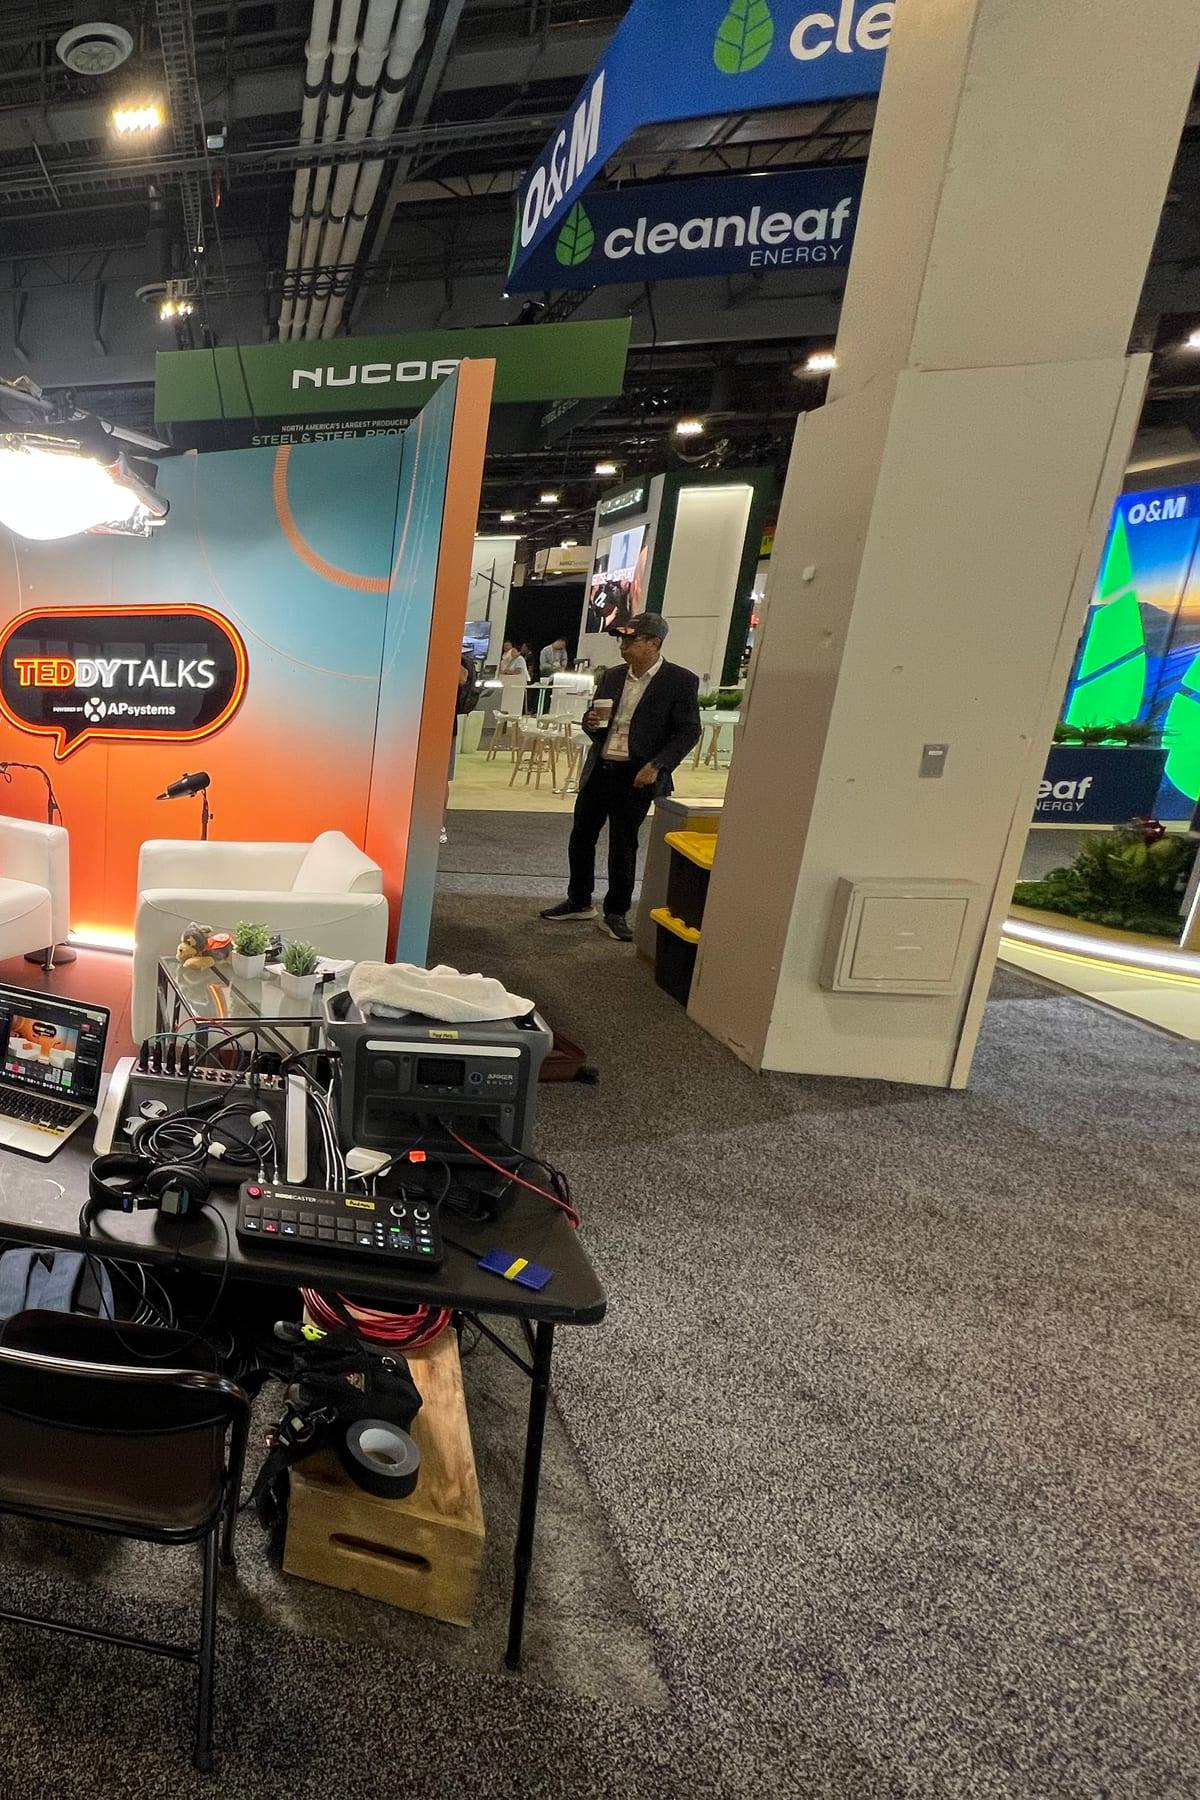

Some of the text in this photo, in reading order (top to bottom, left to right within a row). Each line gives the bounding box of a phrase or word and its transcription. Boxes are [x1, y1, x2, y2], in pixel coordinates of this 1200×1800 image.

[521, 69, 607, 248] O&M
[604, 197, 853, 260] cleanleaf
[749, 244, 844, 267] ENERGY
[282, 424, 304, 433] NORTH
[304, 422, 340, 432] AMERICA'S
[341, 420, 371, 430] LARGEST
[372, 418, 408, 428] PRODUCER
[252, 433, 298, 446] STEEL
[301, 432, 311, 443] &
[1128, 496, 1187, 525] O&M
[13, 658, 217, 689] TEDDYTALKS
[107, 702, 176, 717] APsystems
